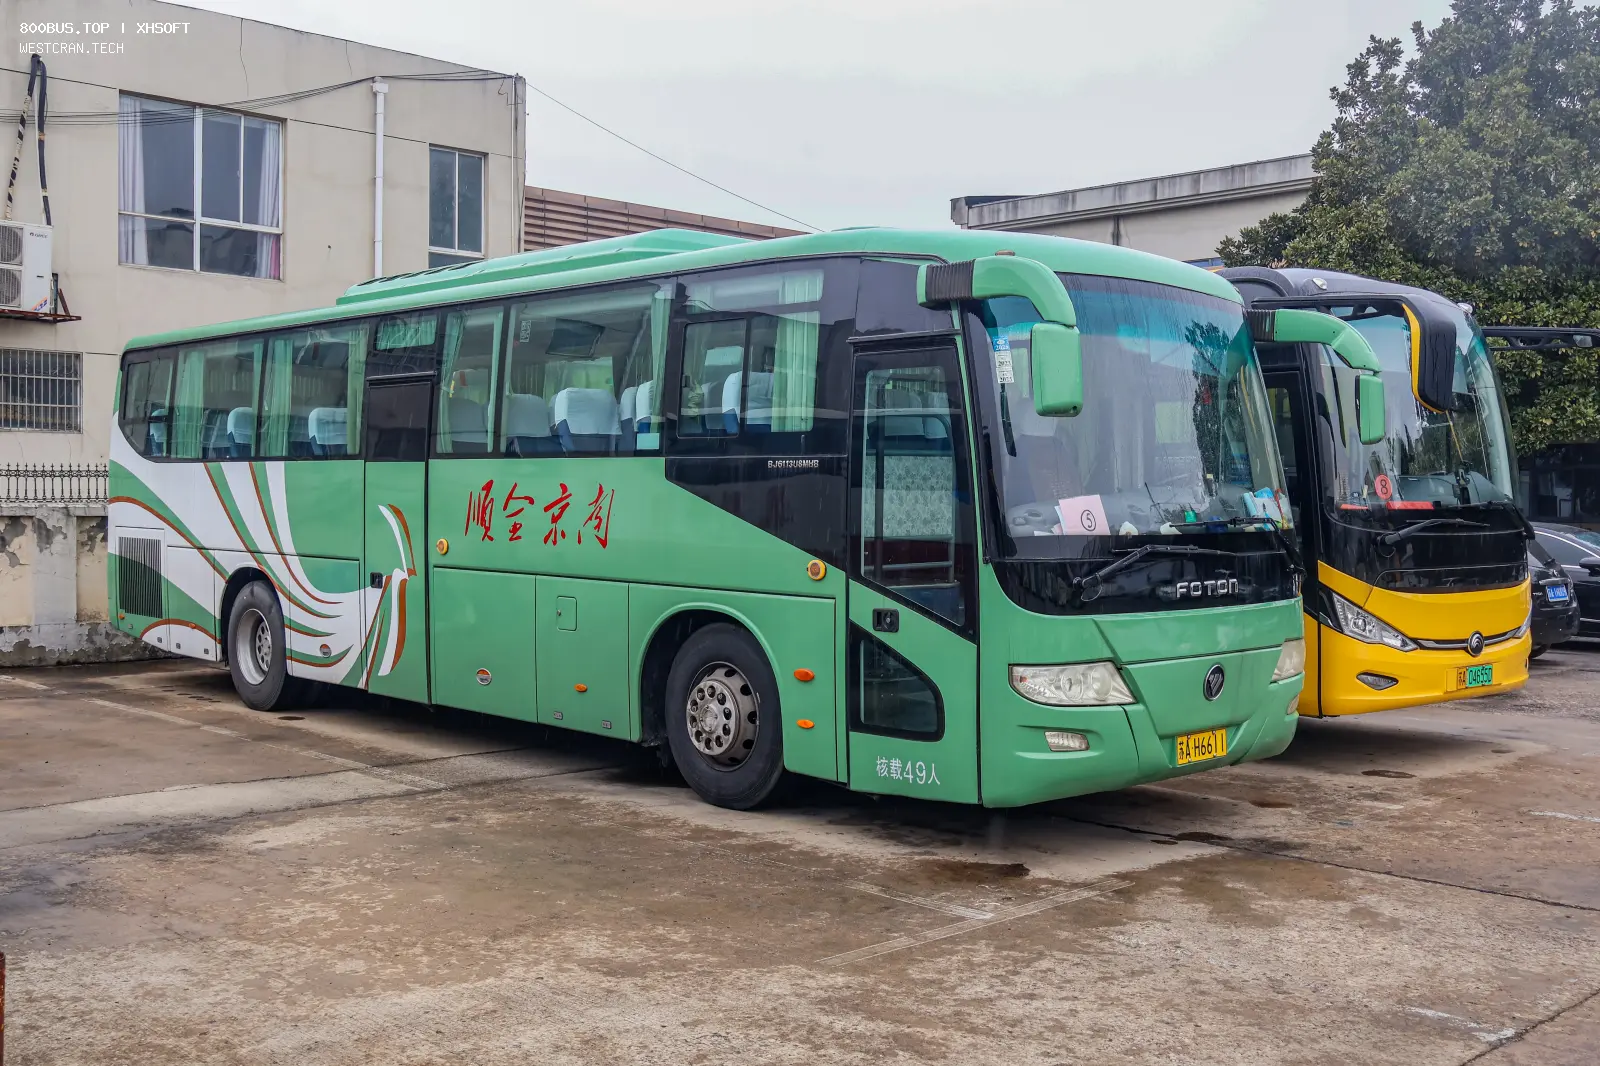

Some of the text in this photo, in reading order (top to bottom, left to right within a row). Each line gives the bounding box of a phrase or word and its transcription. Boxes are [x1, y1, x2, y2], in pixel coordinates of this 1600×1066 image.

[1379, 478, 1389, 495] 8
[876, 755, 941, 786] 核载49人
